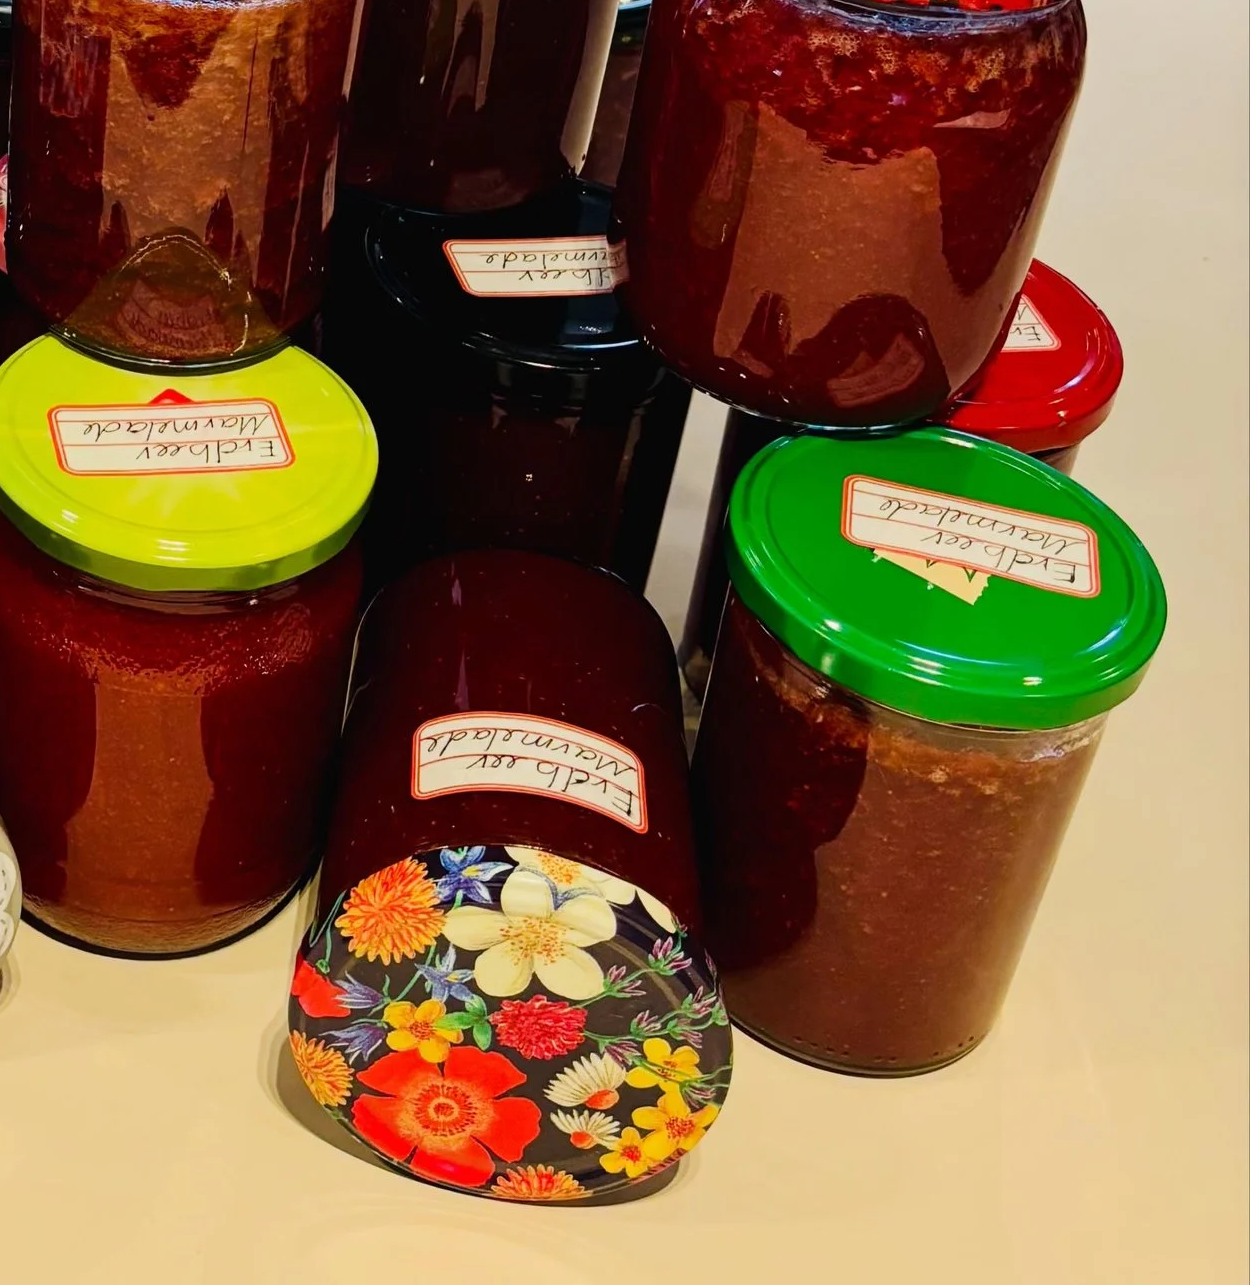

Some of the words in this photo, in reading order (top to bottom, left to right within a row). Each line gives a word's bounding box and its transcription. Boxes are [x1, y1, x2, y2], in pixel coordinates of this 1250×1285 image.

[83, 414, 272, 442] Marmelade
[136, 439, 277, 464] Erdbeer
[879, 498, 1088, 555] Marmelade
[921, 531, 1077, 584] Erdbeer
[427, 728, 637, 777] Marmelade
[465, 754, 634, 817] Erdbeer
